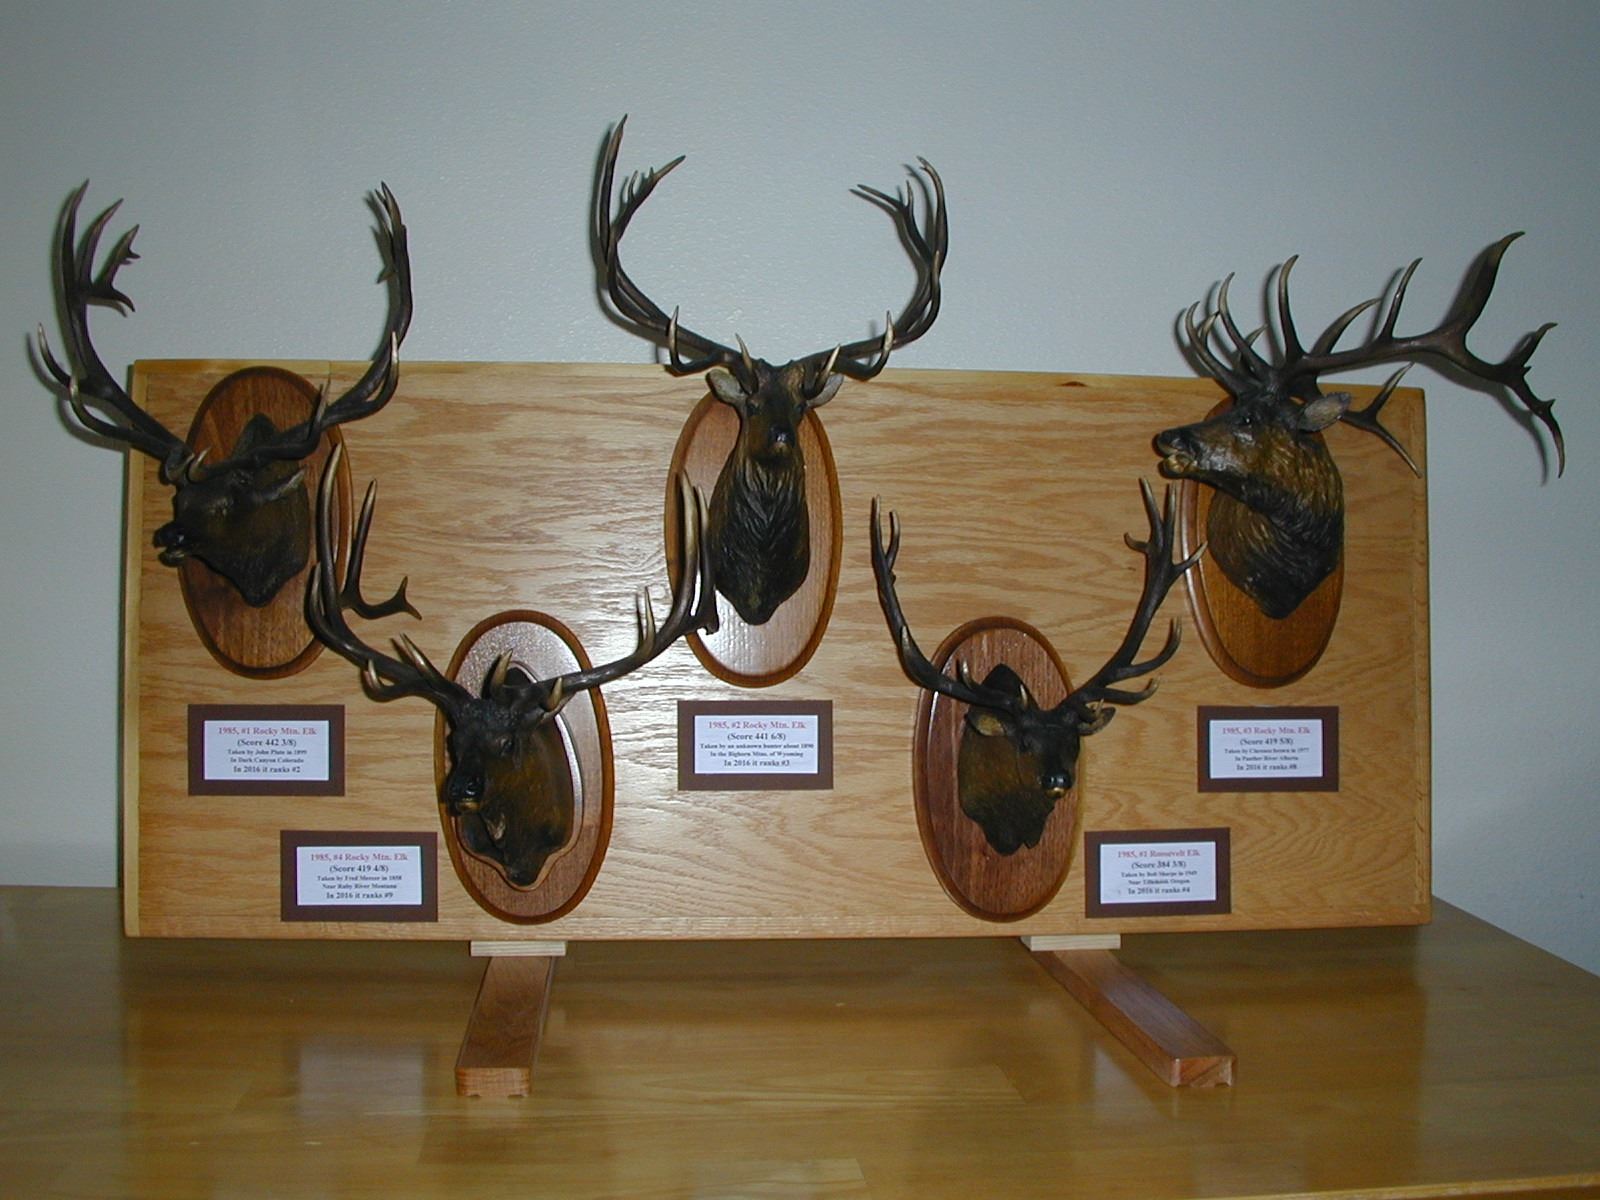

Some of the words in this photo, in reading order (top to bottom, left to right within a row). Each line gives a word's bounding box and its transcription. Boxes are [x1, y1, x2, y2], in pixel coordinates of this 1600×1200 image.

[743, 721, 767, 729] Rocky
[770, 721, 789, 729] Mtn.
[792, 721, 806, 729] Elk
[253, 728, 278, 736] Rocky
[727, 733, 753, 741] (Score
[345, 854, 369, 862] Rocky
